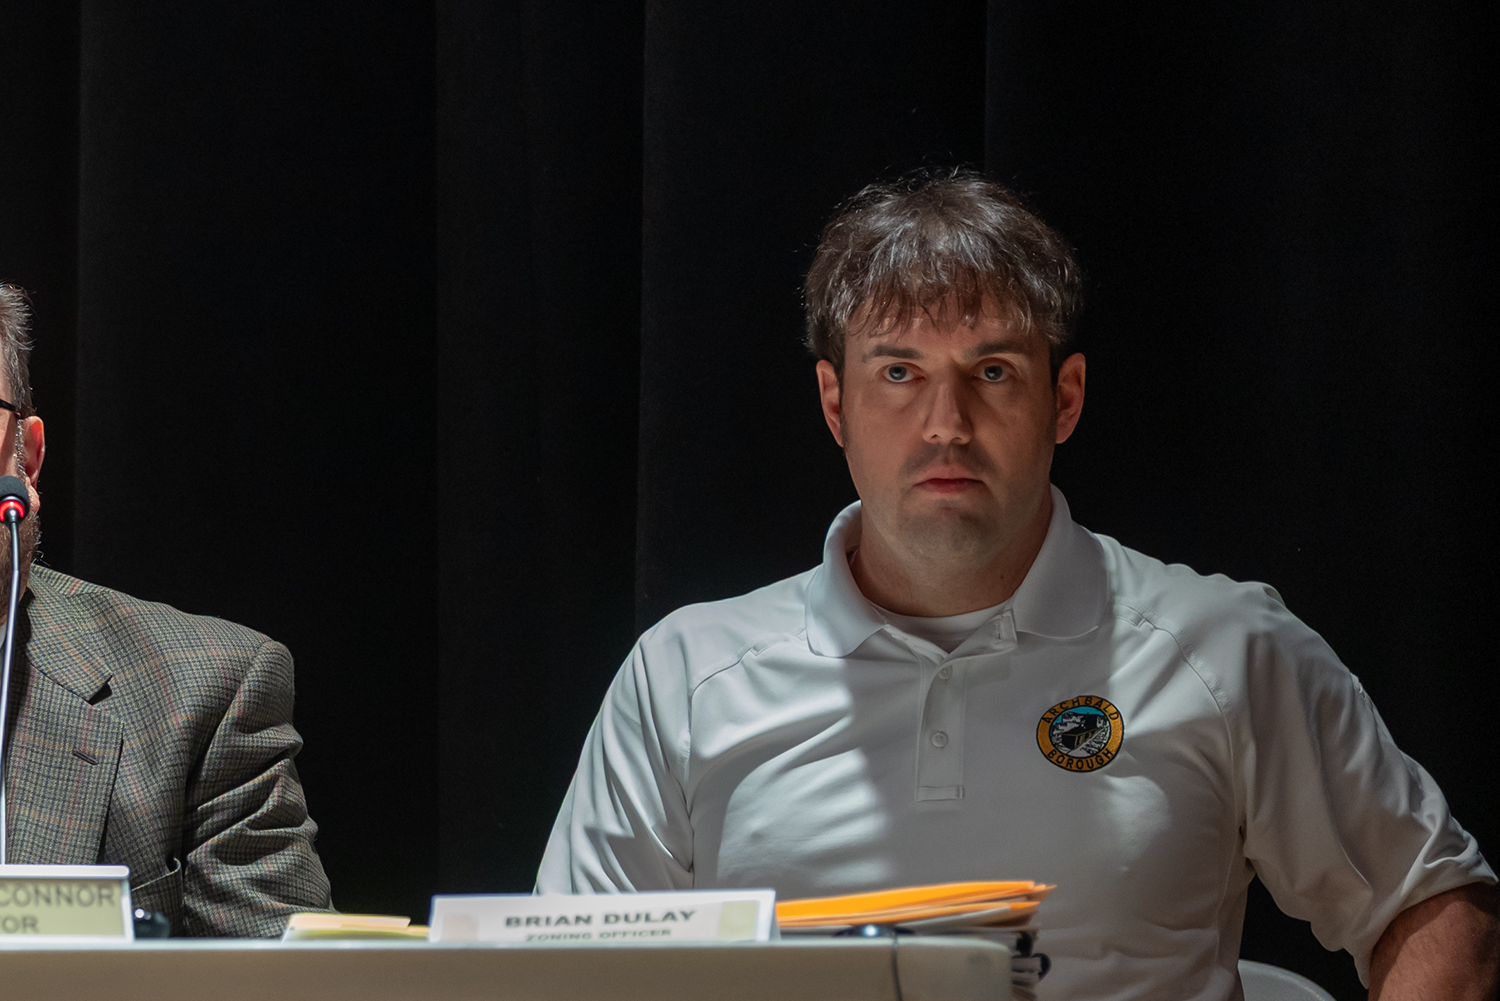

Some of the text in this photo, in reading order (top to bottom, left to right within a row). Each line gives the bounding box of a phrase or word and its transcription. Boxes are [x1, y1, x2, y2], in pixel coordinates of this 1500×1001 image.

[1041, 697, 1120, 723] ARCHBALD
[1047, 748, 1114, 770] BOROUGH
[504, 910, 696, 928] BRIAN DULAY
[525, 929, 671, 942] ZONING OFFICER
